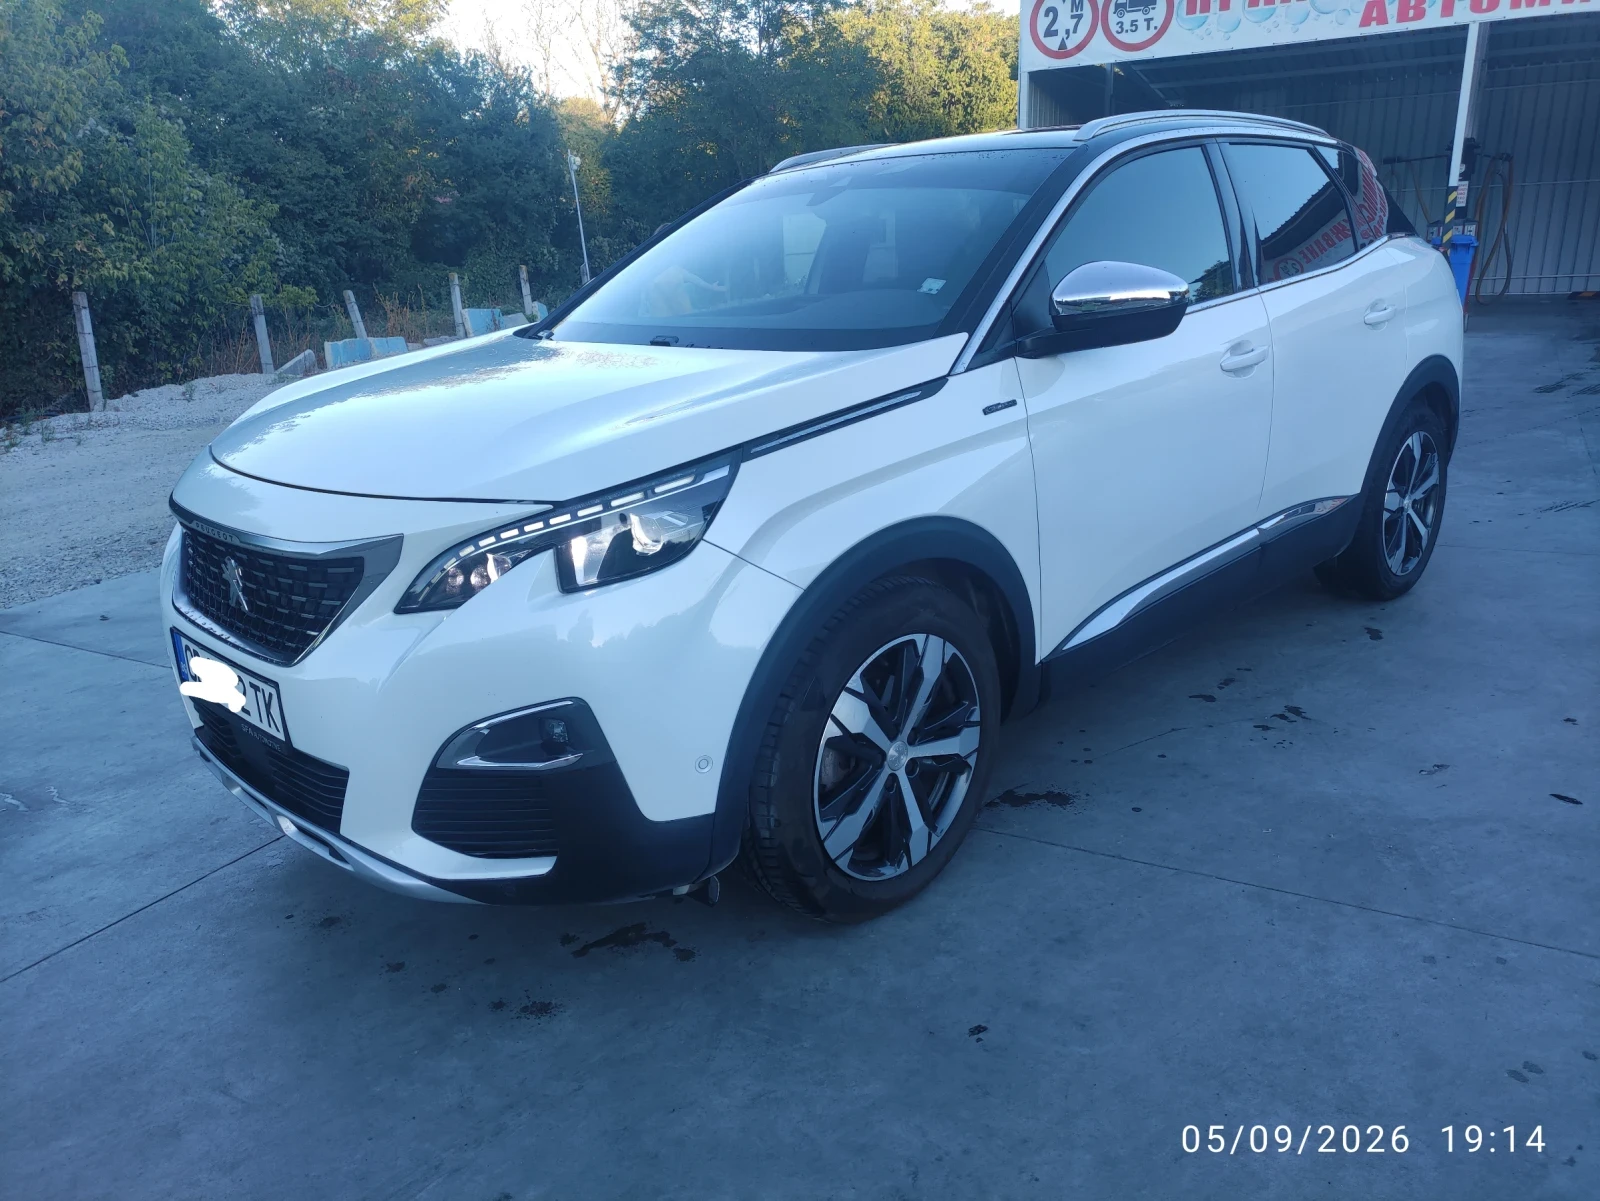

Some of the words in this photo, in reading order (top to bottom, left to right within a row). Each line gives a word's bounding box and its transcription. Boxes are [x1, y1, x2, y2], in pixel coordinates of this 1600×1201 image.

[1115, 19, 1139, 34] 3.5
[195, 521, 234, 542] PEUGEOT
[249, 681, 281, 733] TK
